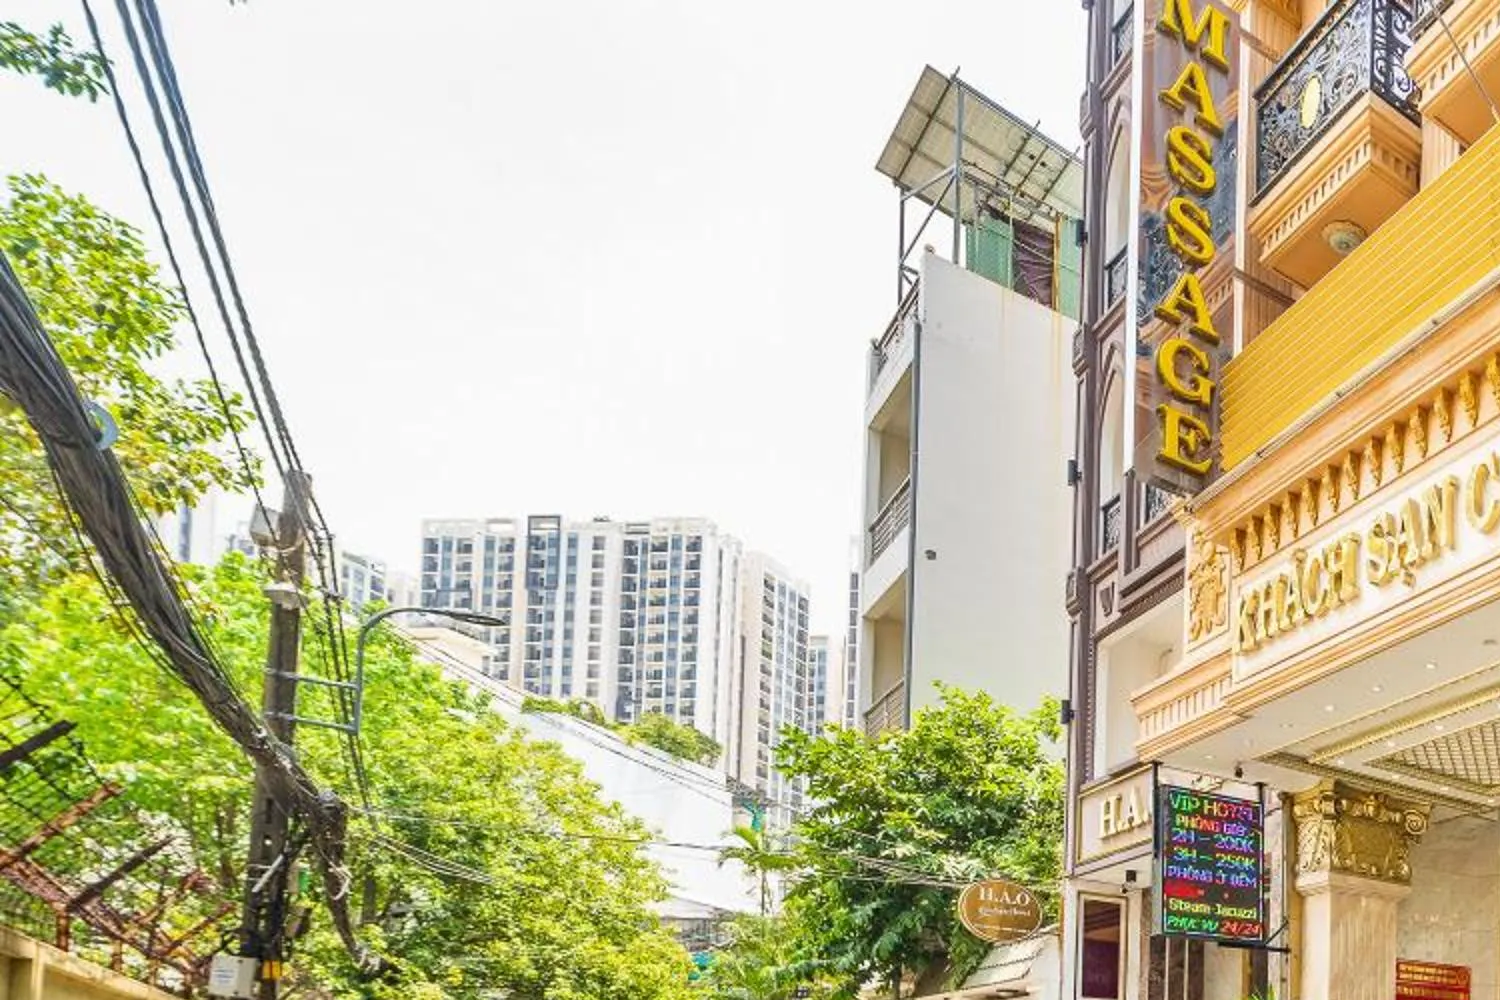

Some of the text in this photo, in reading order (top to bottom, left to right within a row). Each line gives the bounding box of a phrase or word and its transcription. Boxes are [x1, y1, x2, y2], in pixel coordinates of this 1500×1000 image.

[1155, 0, 1230, 475] MASSAGE
[1238, 532, 1361, 656] KHÁCH
[1366, 473, 1458, 587] SẠN
[1169, 792, 1200, 812] VIP
